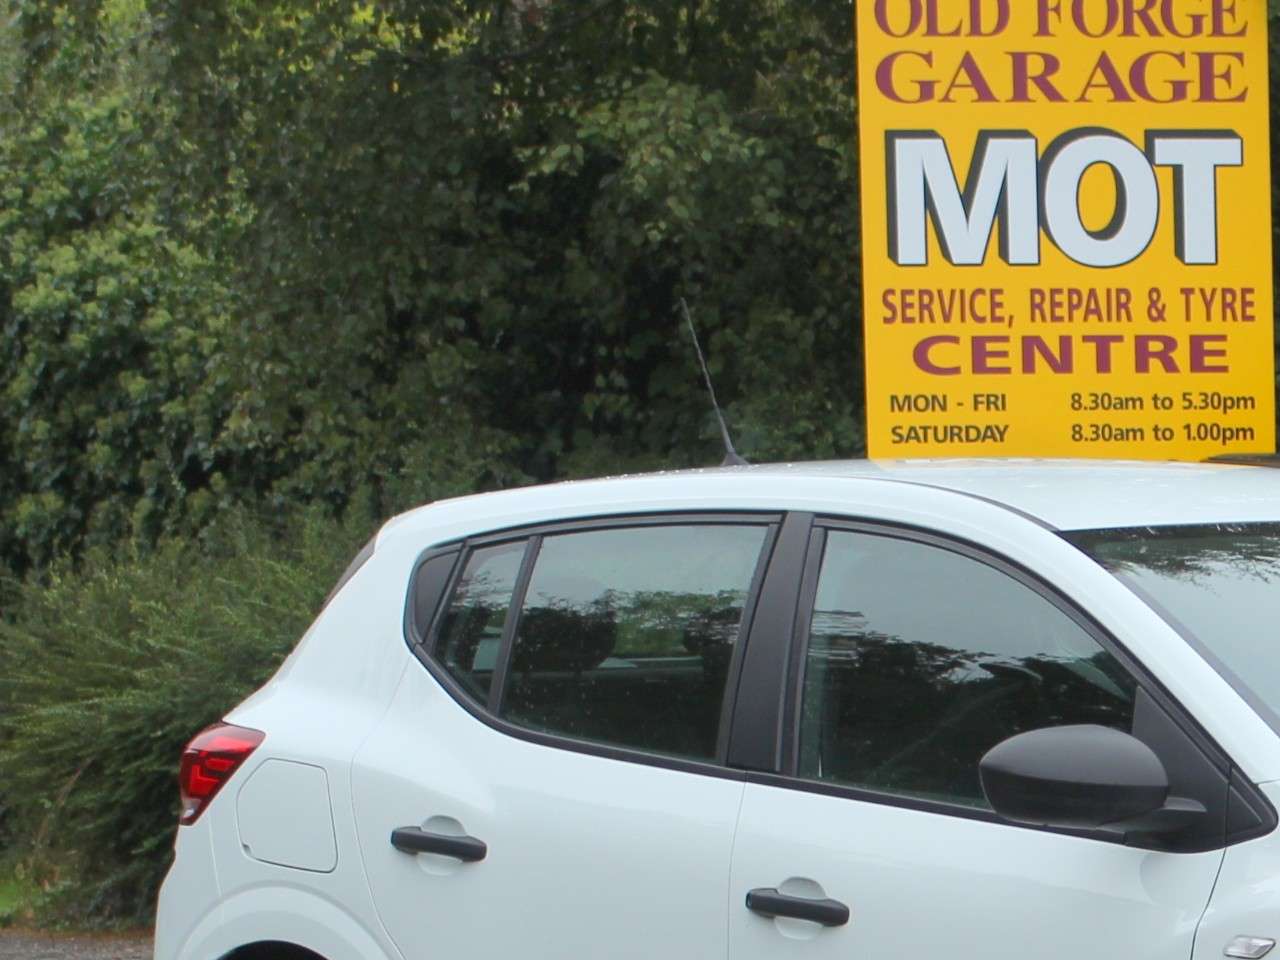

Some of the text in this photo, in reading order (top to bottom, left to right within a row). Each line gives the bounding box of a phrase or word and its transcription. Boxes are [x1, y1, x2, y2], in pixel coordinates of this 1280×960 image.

[874, 0, 1249, 38] OLD FORGE
[875, 50, 1249, 104] GARAGE
[884, 126, 1244, 268] MOT
[881, 286, 1256, 328] SERVICE, REPAIR & TYRE
[912, 334, 1230, 376] CENTRE
[890, 394, 948, 413] MON
[973, 393, 1007, 411] FRI
[1070, 392, 1144, 411] 8.30am
[1152, 394, 1174, 411] to
[1181, 392, 1256, 416] 5.30pm
[891, 423, 1256, 446] SATURDAY 8.30am to 1.00pm
